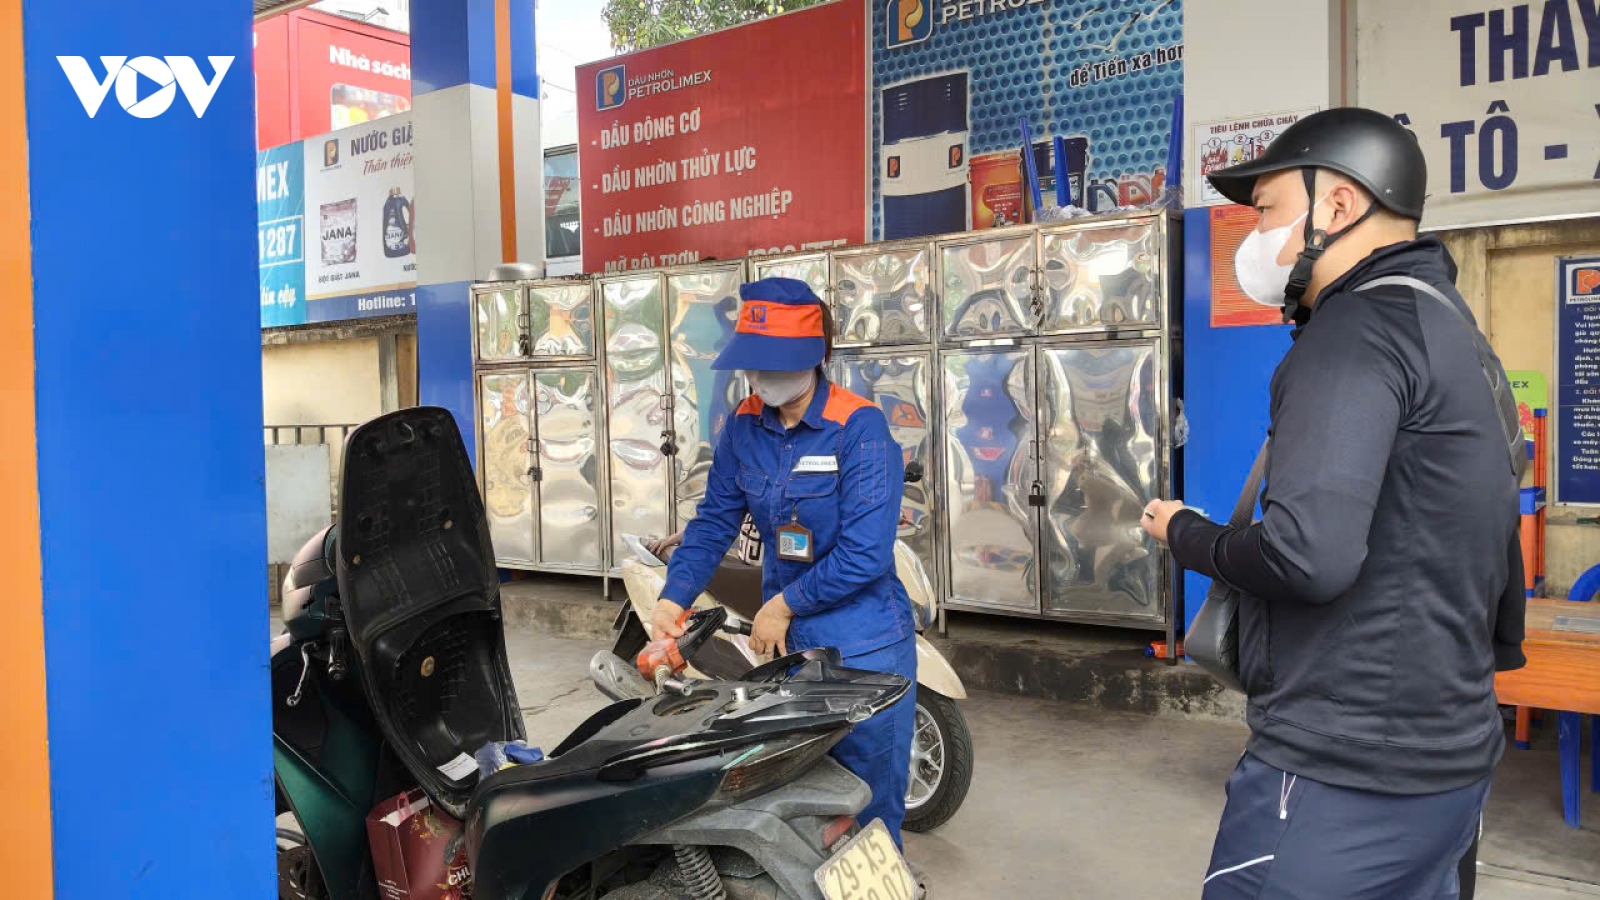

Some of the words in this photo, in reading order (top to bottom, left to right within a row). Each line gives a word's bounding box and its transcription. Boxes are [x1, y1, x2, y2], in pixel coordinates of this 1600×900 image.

[329, 45, 370, 71] Nhà
[372, 60, 410, 80] sách
[1094, 55, 1127, 80] Tiến
[1131, 53, 1152, 71] xa
[628, 70, 712, 100] PETROLIMEX
[351, 130, 387, 157] NƯỚC
[600, 119, 629, 150] DẦU
[634, 114, 675, 146] ĐỘNG
[679, 107, 701, 132] CƠ
[1440, 99, 1518, 194] TÔ
[602, 165, 631, 194] DẦU
[634, 158, 678, 188] NHỜN
[681, 148, 720, 180] THỦY
[724, 146, 757, 177] LỰC
[603, 209, 632, 238] DẦU
[635, 204, 678, 233] NHỜN
[682, 199, 725, 228] CÔNG
[730, 186, 793, 220] NGHIỆP
[322, 226, 353, 241] JANA
[358, 295, 406, 312] Hotline:
[1510, 380, 1530, 388] EX
